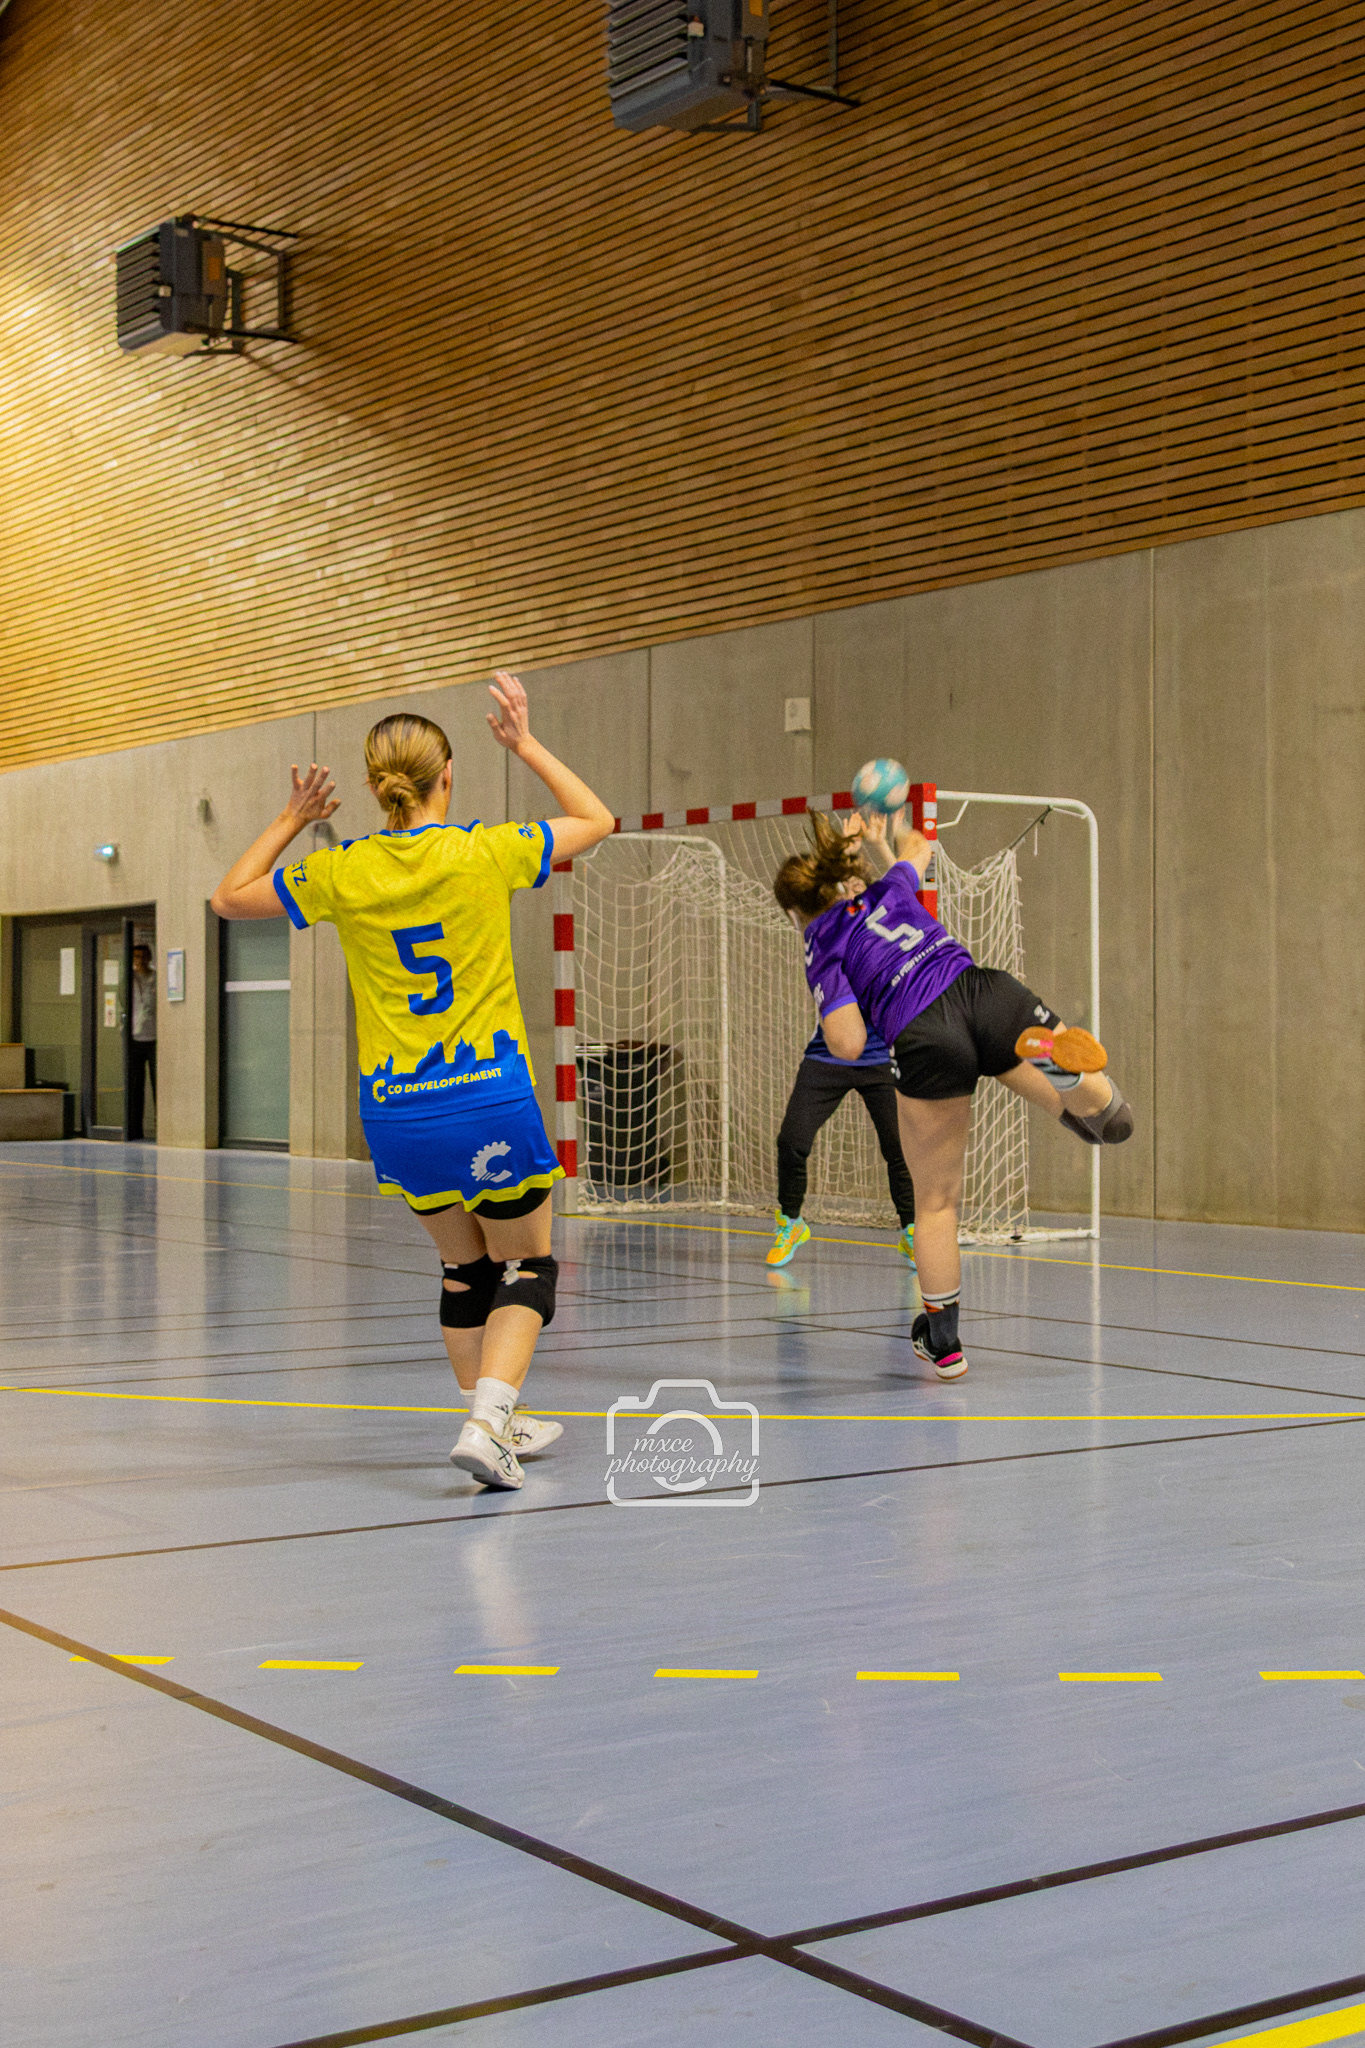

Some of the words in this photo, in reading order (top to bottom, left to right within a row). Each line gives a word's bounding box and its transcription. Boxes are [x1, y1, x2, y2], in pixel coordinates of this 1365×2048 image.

[865, 905, 925, 952] 5
[390, 922, 454, 1016] 5
[387, 1084, 403, 1095] CO
[404, 1067, 502, 1093] DEVELOPPEMENT
